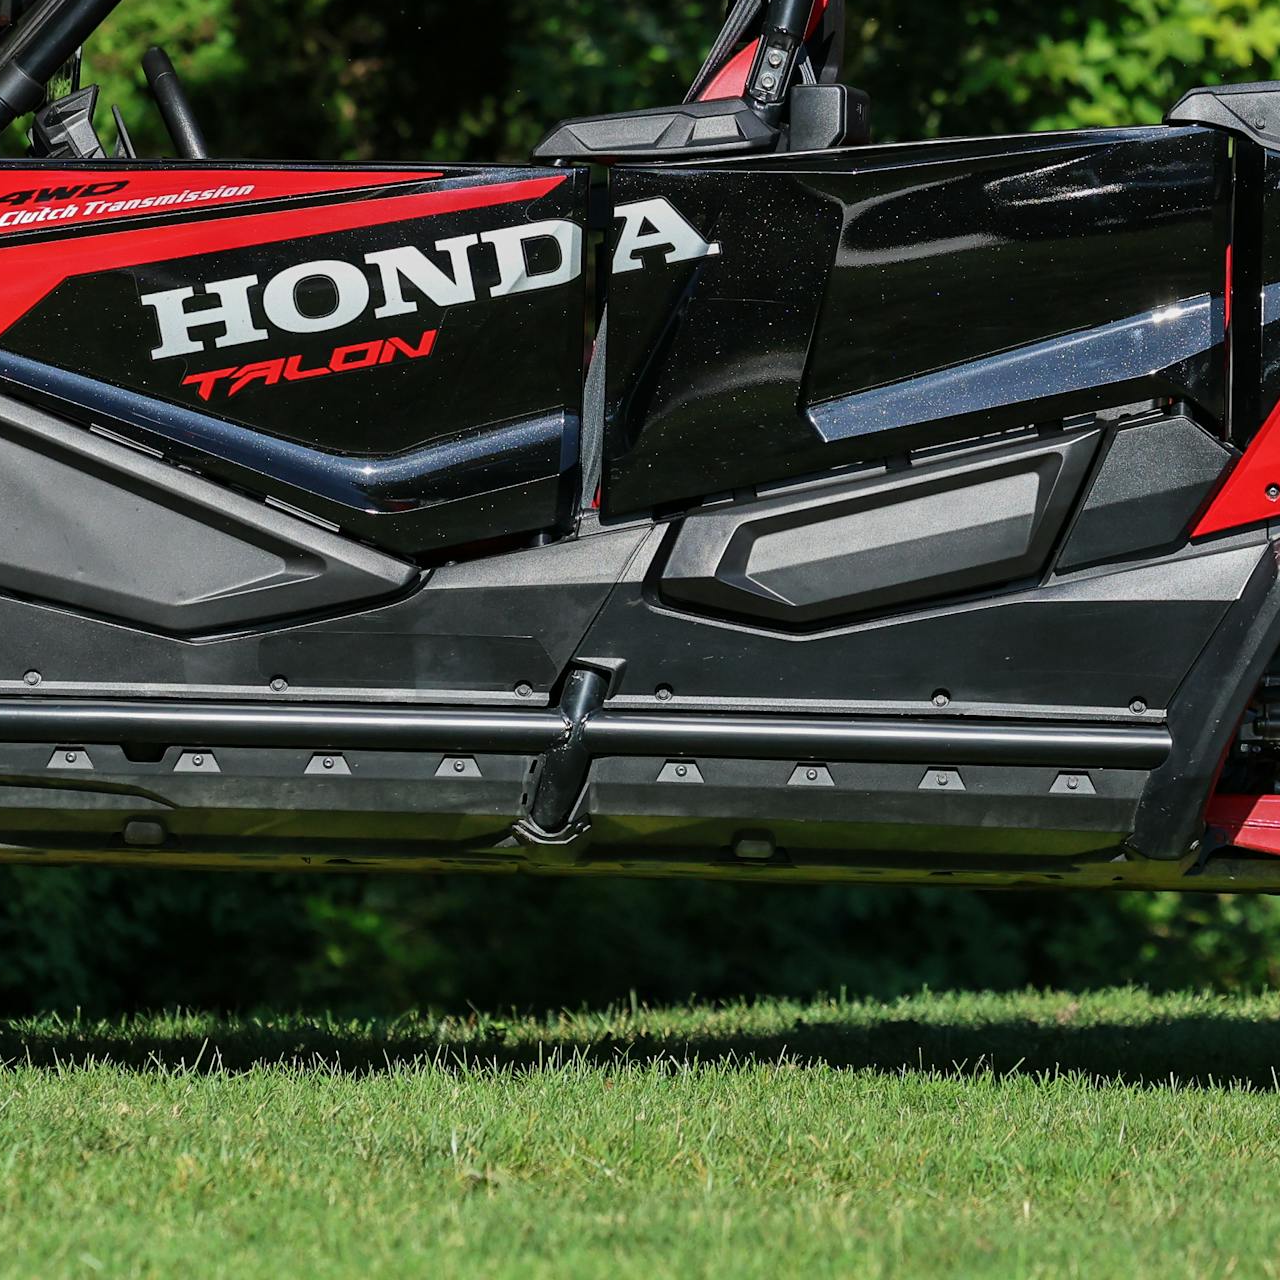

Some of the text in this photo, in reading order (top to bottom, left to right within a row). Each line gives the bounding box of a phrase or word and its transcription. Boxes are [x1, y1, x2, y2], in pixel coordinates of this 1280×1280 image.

[82, 183, 255, 216] Transmission
[140, 196, 720, 361] HONDA
[182, 328, 438, 401] TALON
